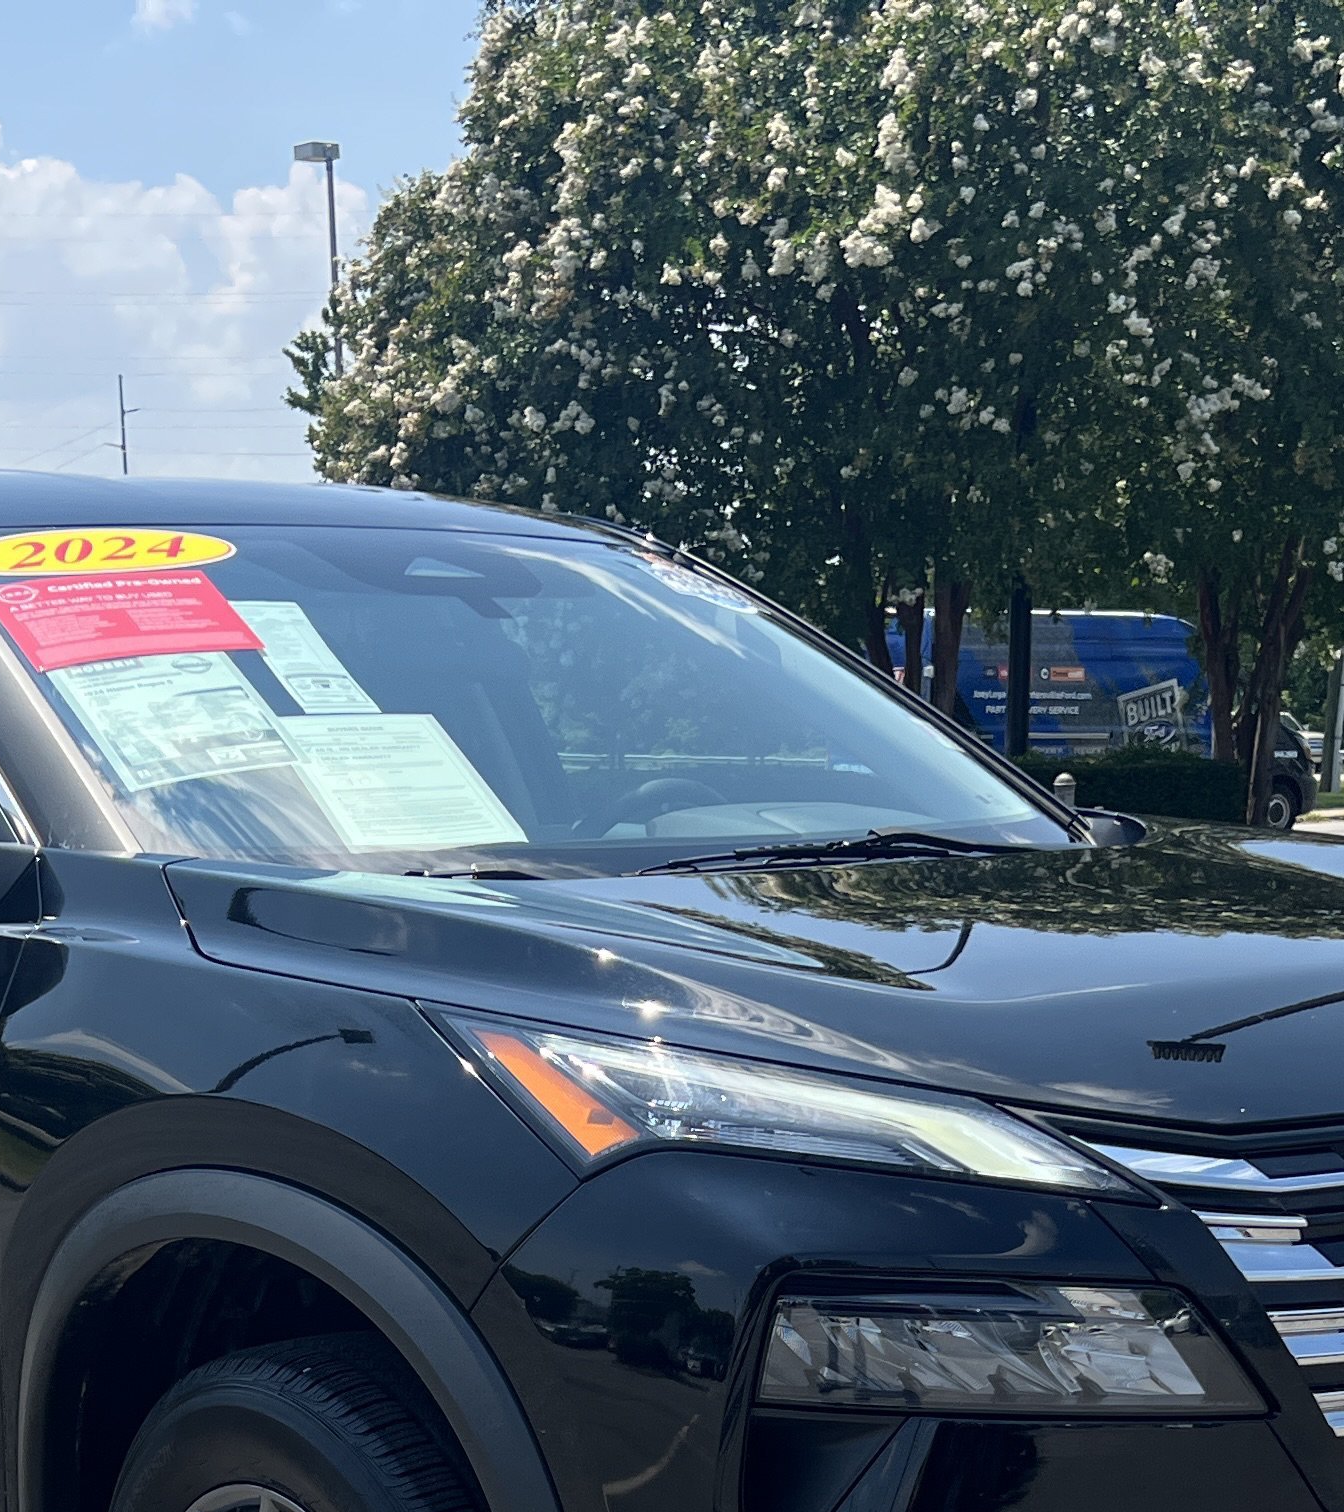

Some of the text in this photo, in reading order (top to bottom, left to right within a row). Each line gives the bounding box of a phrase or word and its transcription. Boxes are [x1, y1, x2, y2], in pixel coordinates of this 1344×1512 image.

[10, 535, 185, 570] 2024
[47, 576, 201, 593] Certified Pre-Owned
[10, 590, 173, 613] A BETTER WAY TO BUY USED
[1048, 705, 1080, 715] SERVICE
[1126, 691, 1173, 726] BUILT
